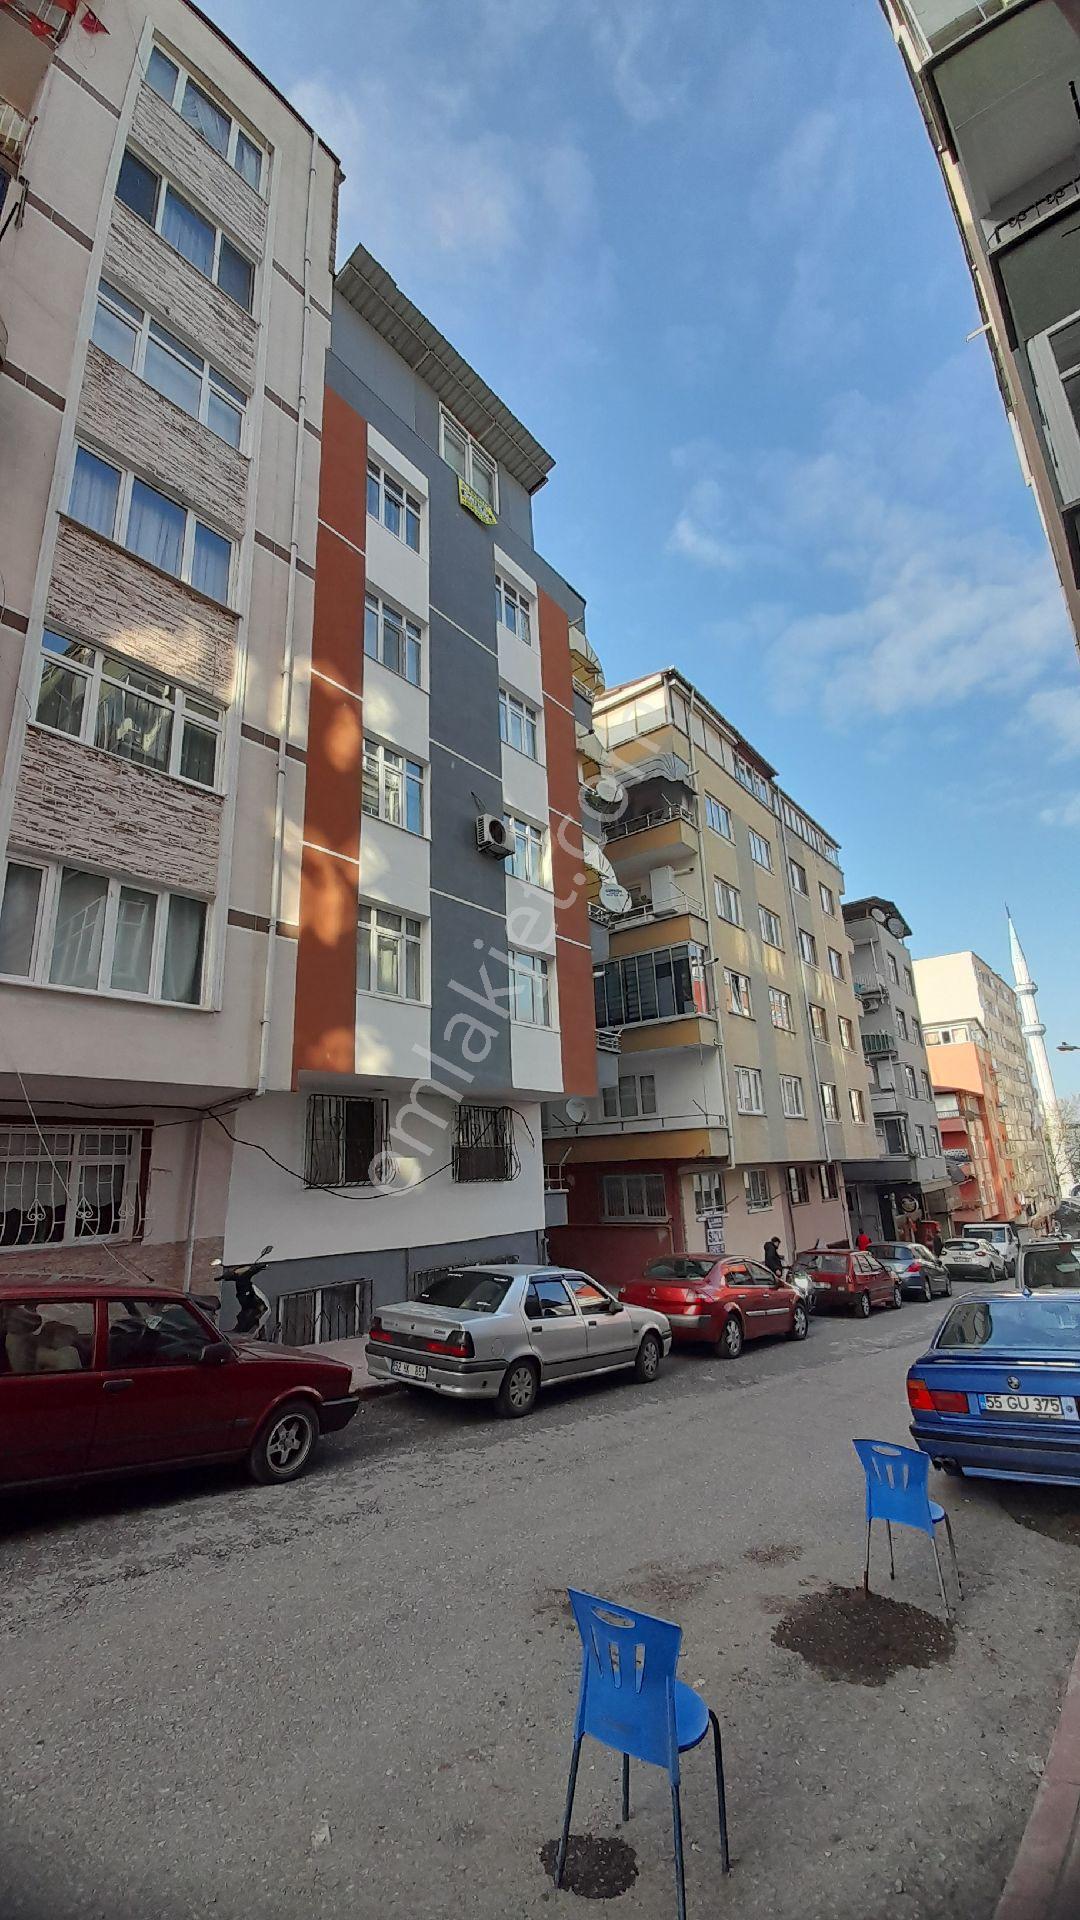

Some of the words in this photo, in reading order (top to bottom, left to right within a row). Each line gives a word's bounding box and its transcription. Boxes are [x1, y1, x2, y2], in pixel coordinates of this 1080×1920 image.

[985, 1396, 1002, 1409] 55
[1007, 1396, 1030, 1411] GU
[1033, 1397, 1060, 1412] 375
